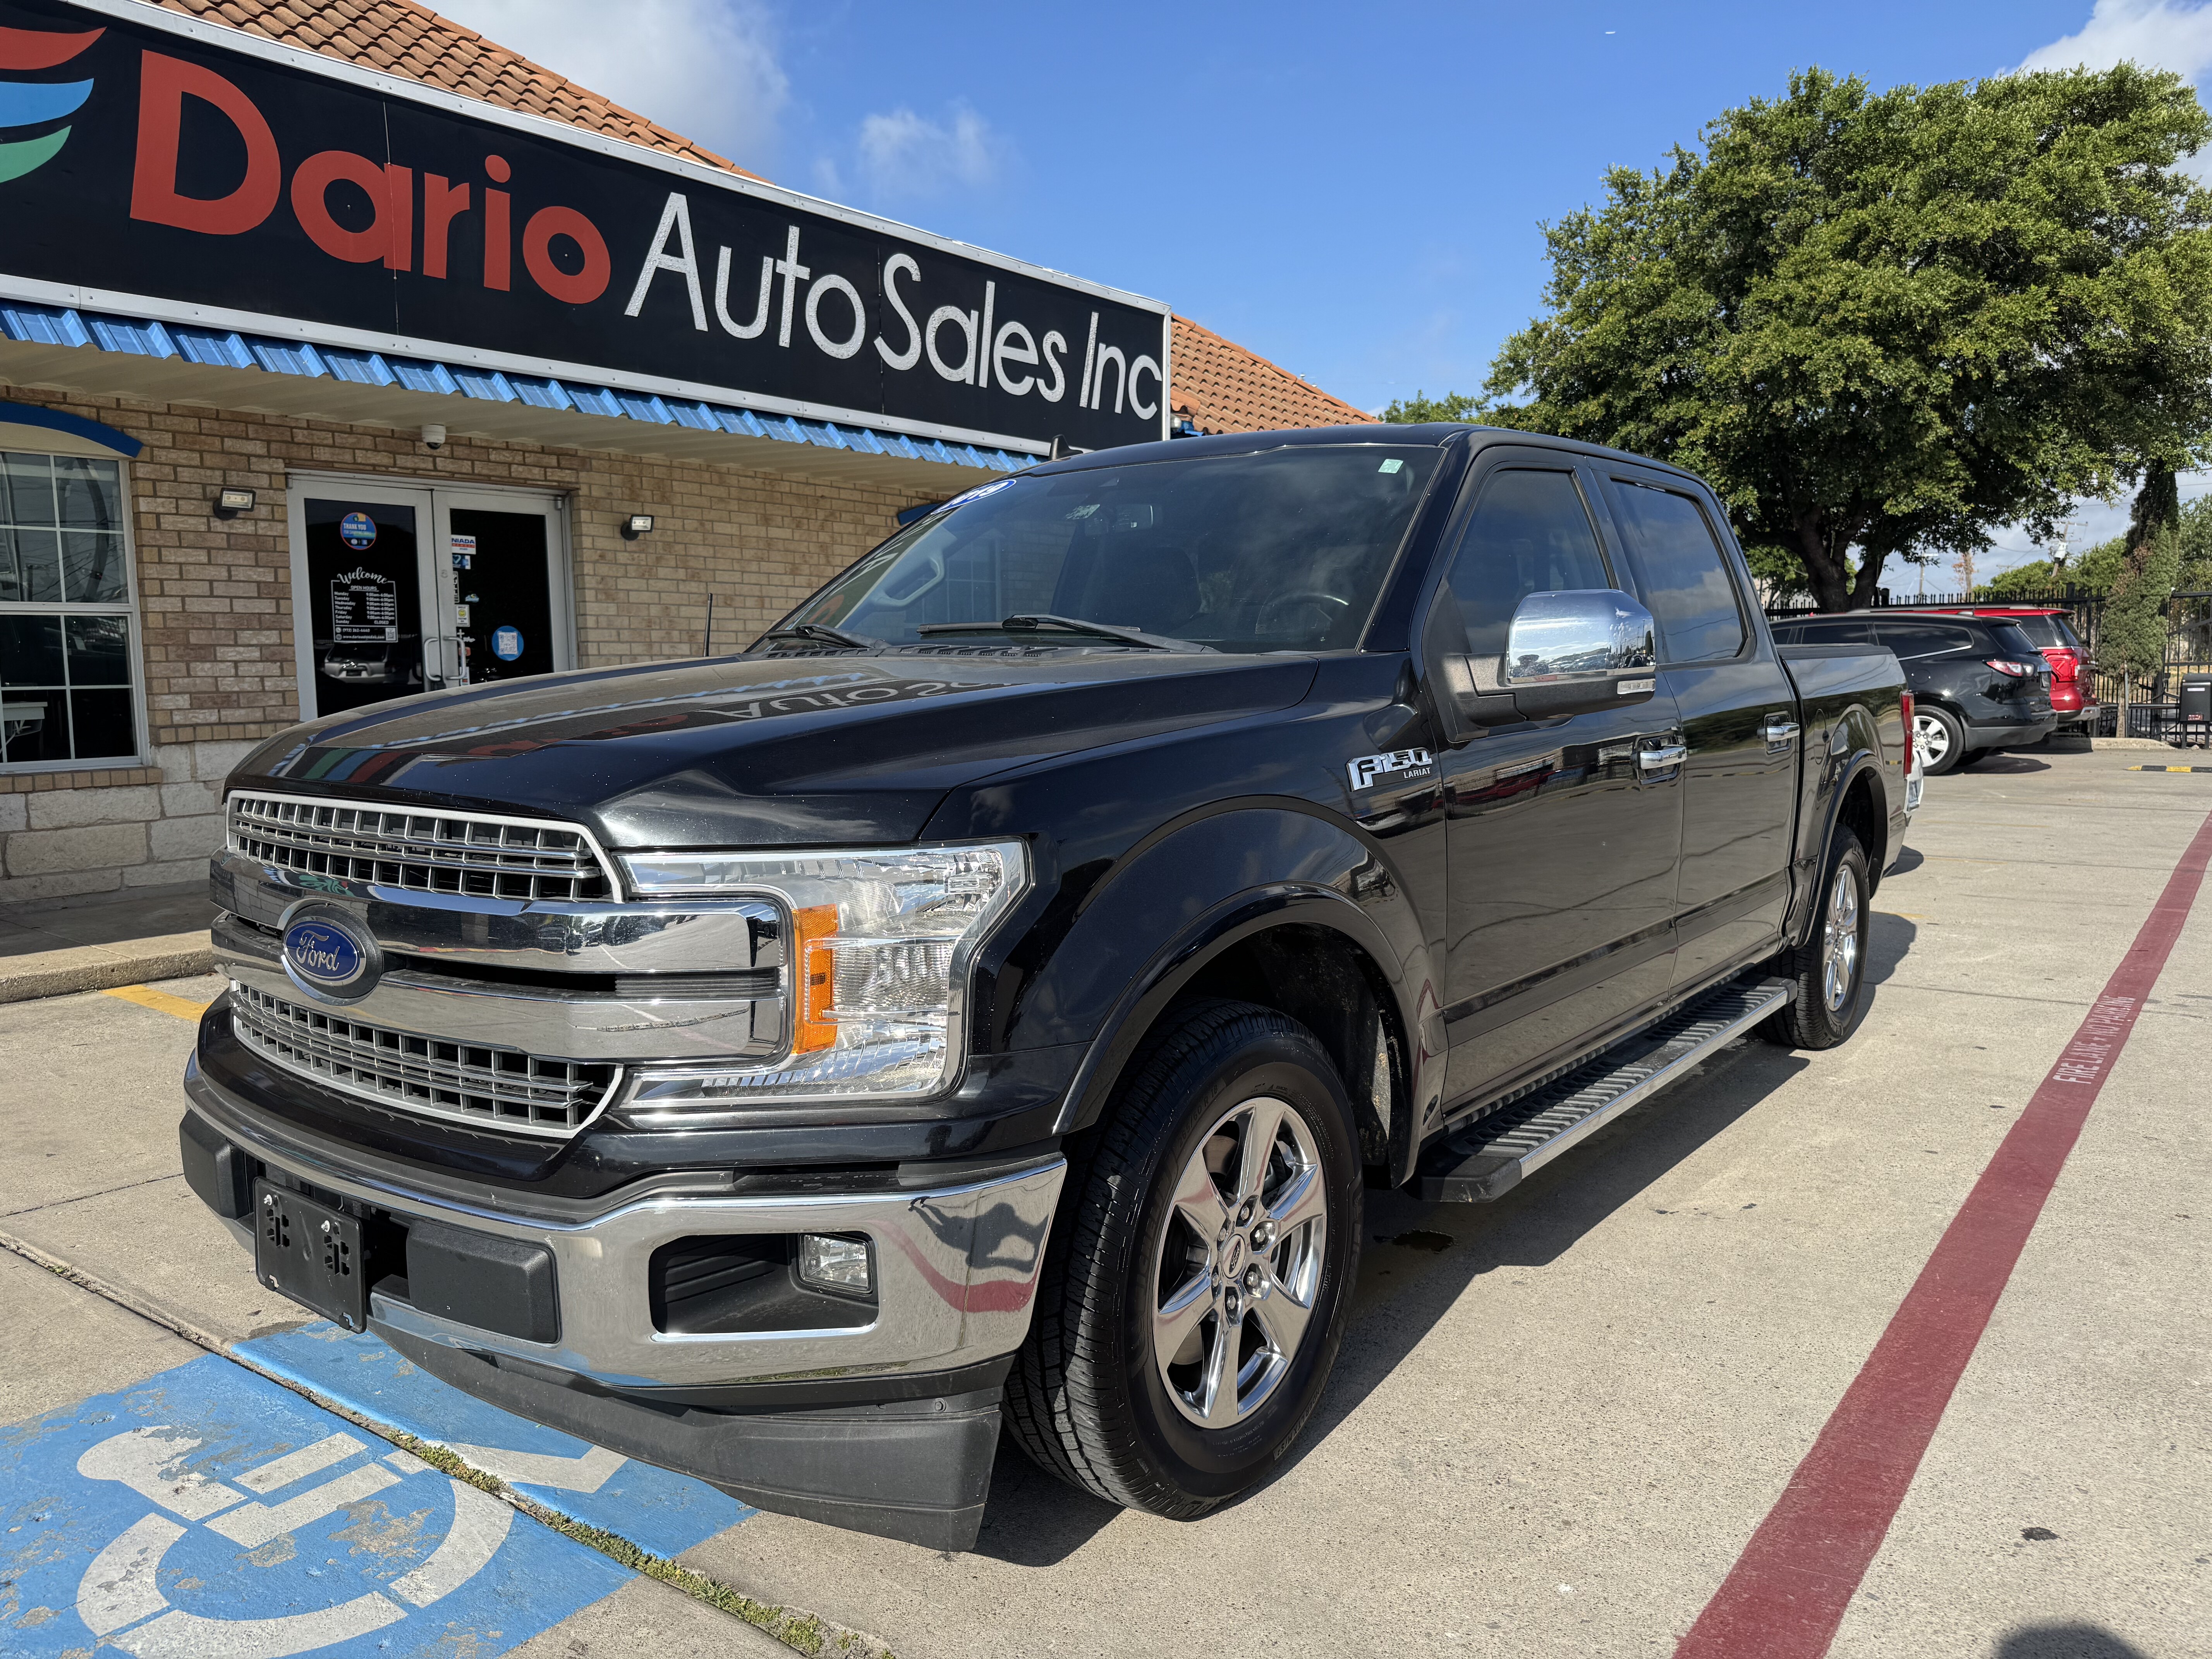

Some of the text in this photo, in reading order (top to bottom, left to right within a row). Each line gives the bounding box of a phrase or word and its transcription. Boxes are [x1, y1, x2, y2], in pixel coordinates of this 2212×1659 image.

[130, 49, 611, 304] Dario
[1080, 311, 1162, 421] Inc
[337, 567, 388, 584] Welcome
[1403, 767, 1431, 779] LARIAT
[296, 930, 340, 971] Ford
[2052, 995, 2136, 1084] FIRE LANE NO PARKING
[1231, 1246, 1240, 1269] Ford
[1306, 1360, 1331, 1417] DEFENDER
